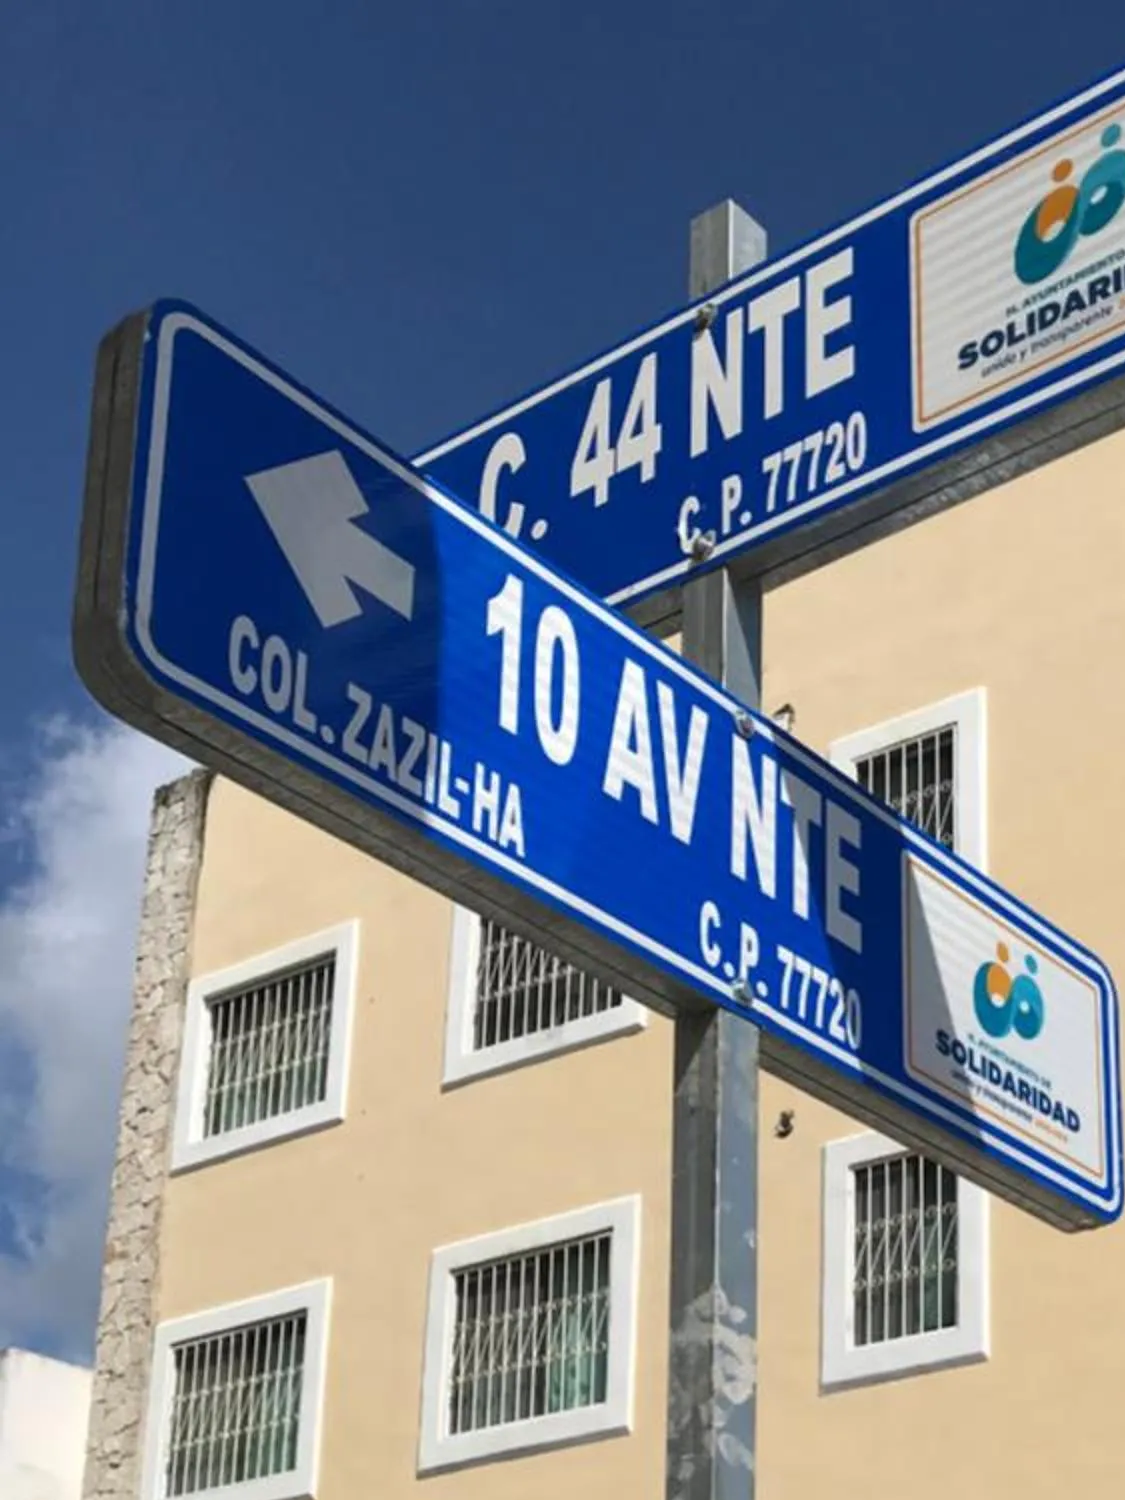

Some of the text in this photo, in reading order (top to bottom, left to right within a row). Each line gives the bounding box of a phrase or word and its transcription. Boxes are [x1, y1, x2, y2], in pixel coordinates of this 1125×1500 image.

[569, 351, 662, 508] 44
[690, 246, 855, 460] NTE
[762, 410, 867, 513] 77720
[486, 572, 863, 955] 10 AV NTE
[776, 943, 862, 1051] 77720
[935, 1028, 1081, 1133] SOLIDARIDAD
